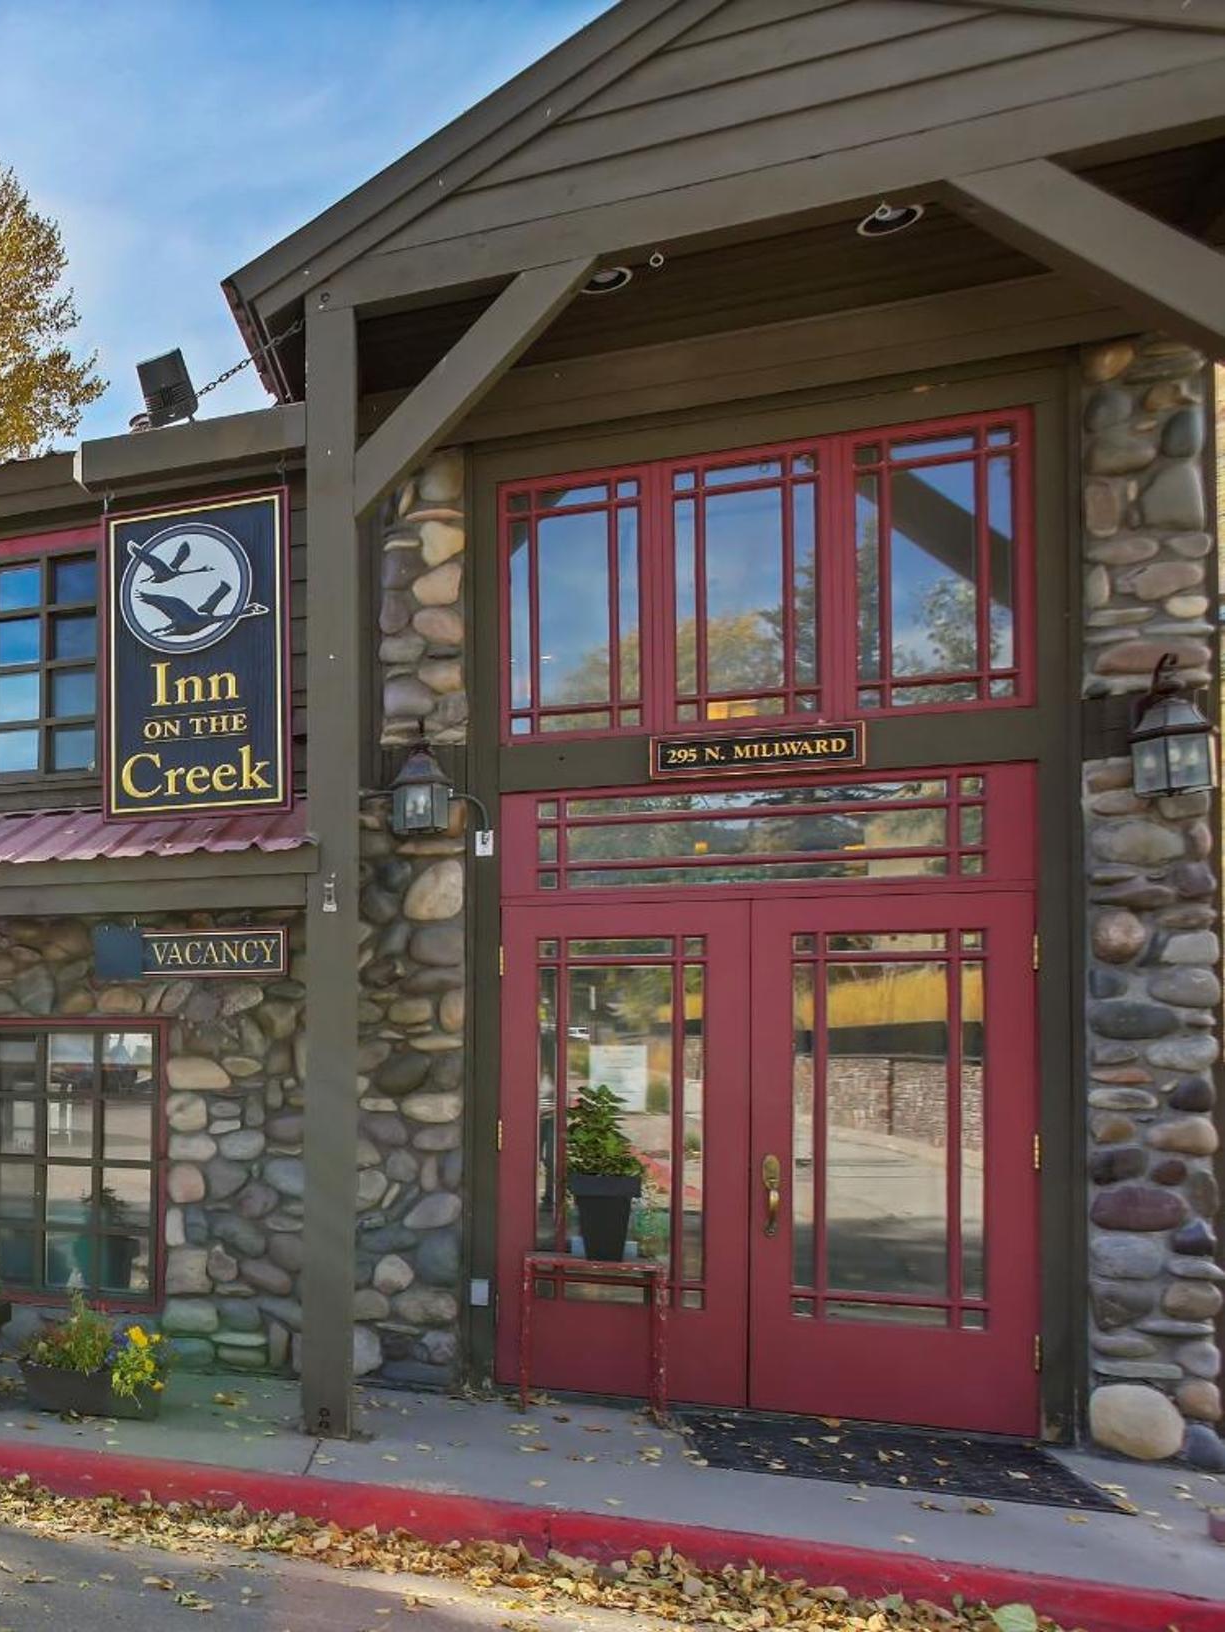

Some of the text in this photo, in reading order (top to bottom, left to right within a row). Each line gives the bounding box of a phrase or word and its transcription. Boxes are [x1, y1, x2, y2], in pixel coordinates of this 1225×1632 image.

[150, 661, 239, 707] Inn
[143, 713, 248, 740] ON THE
[666, 737, 847, 764] 295 N. MILLWARD
[122, 744, 274, 799] Creek
[151, 938, 279, 966] VACANCY
